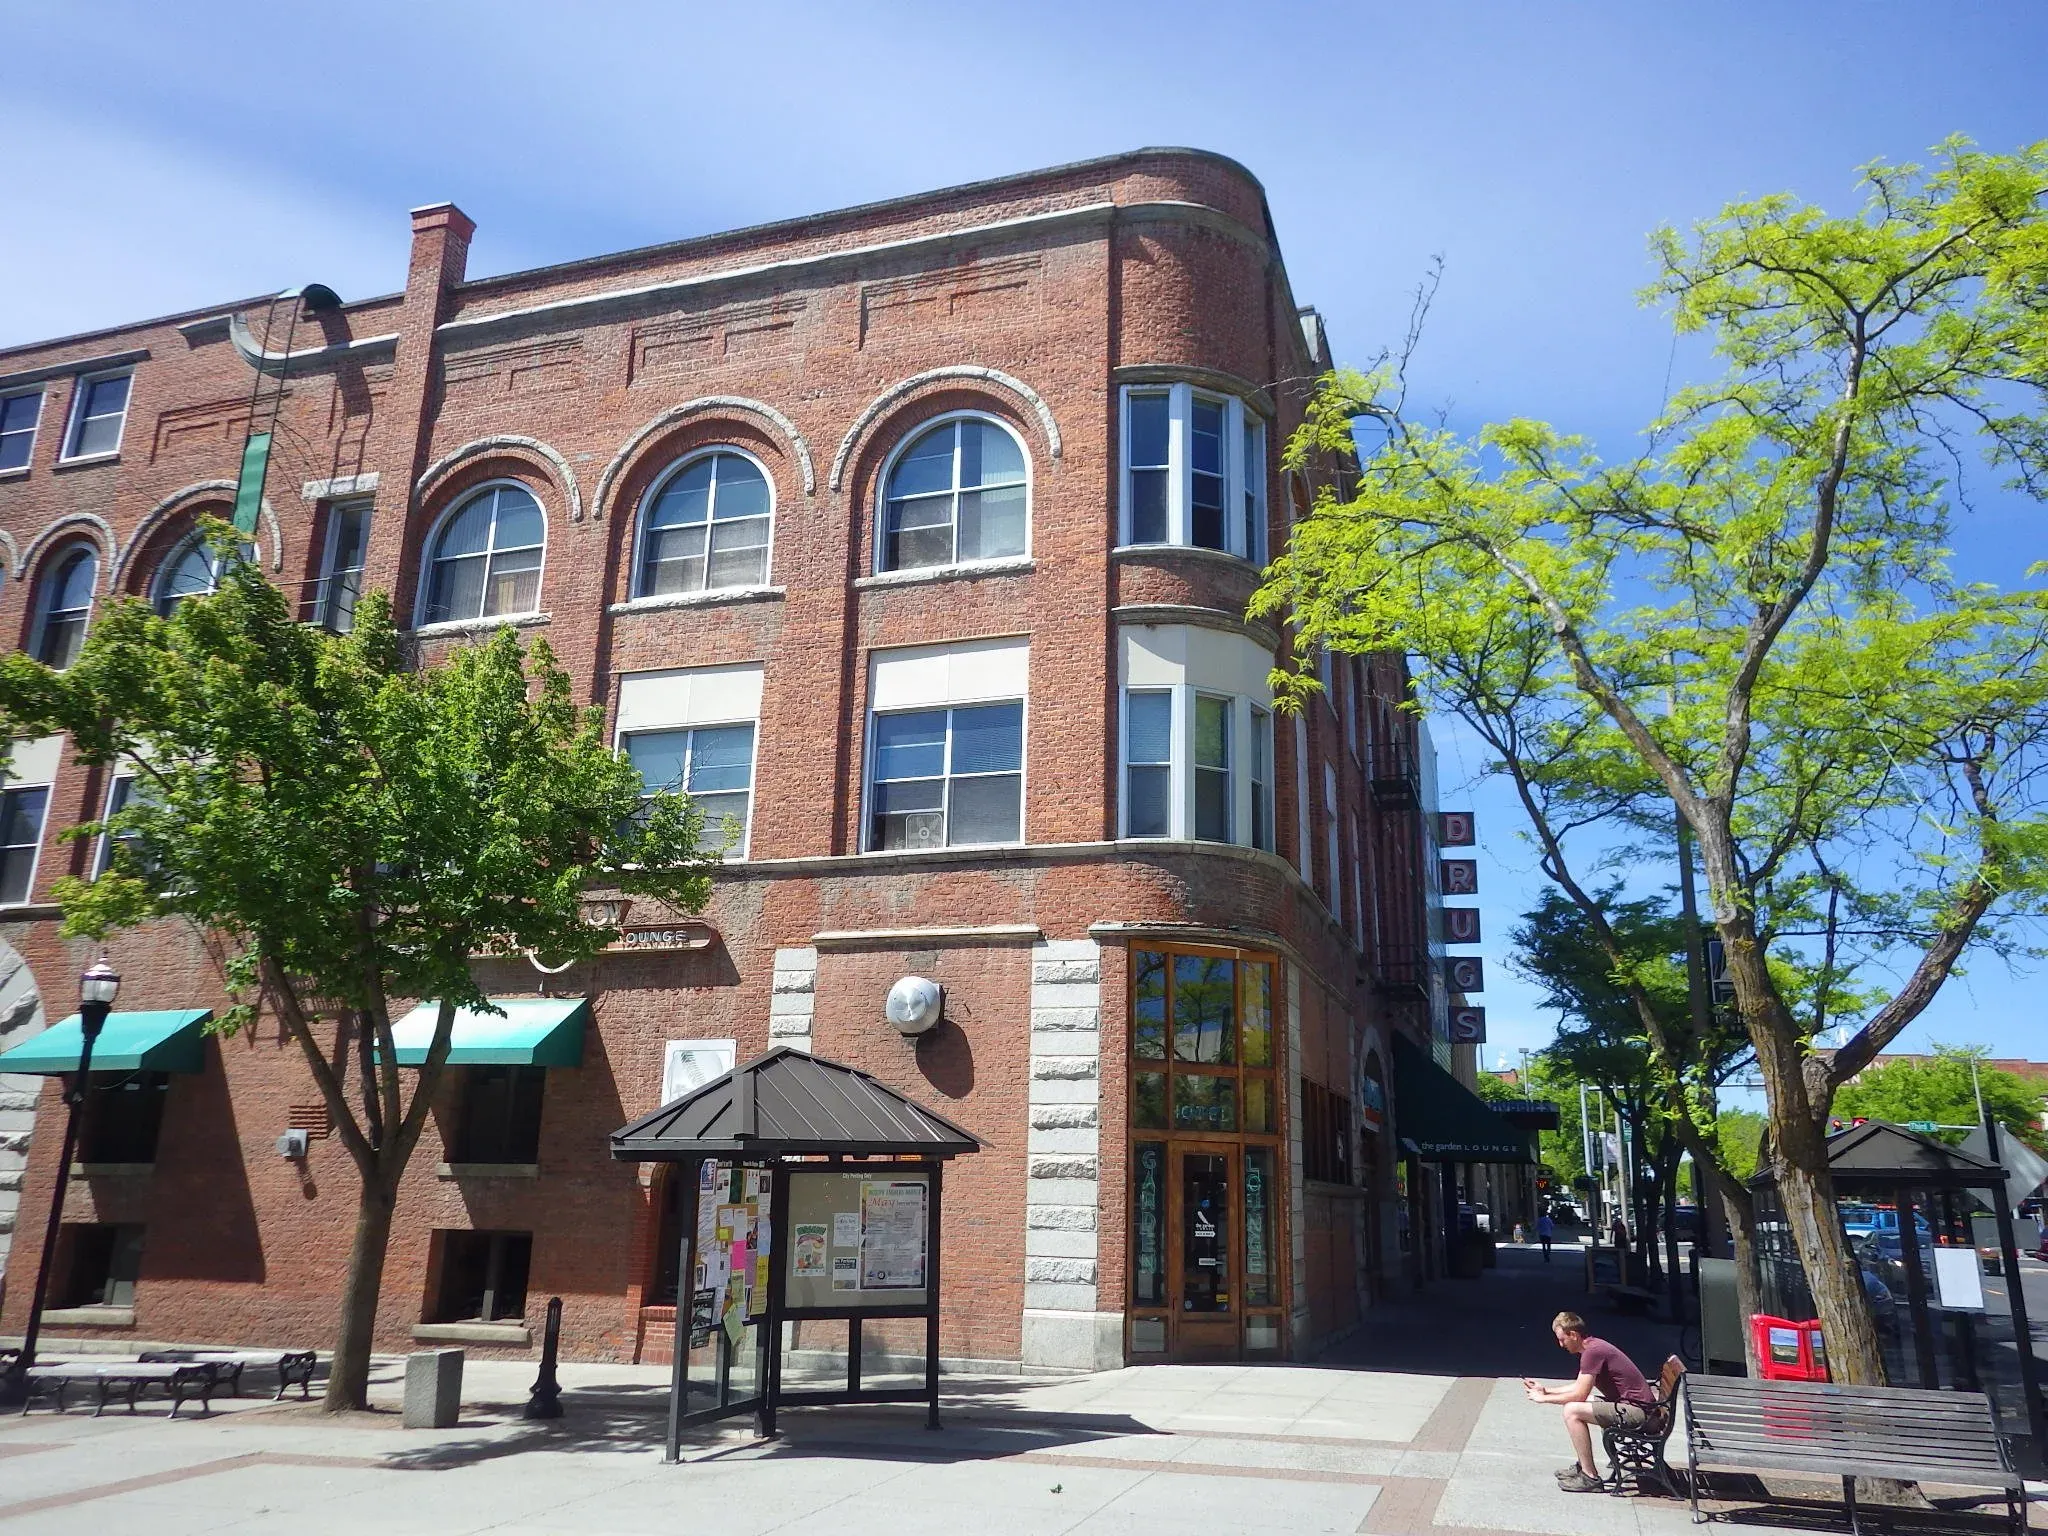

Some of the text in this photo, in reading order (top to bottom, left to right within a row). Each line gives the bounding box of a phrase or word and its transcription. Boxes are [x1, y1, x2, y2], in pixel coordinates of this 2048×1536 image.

[1446, 815, 1479, 1038] DRUGS
[625, 929, 688, 943] OUNGE
[1421, 1141, 1518, 1152] the garden LOUNGE
